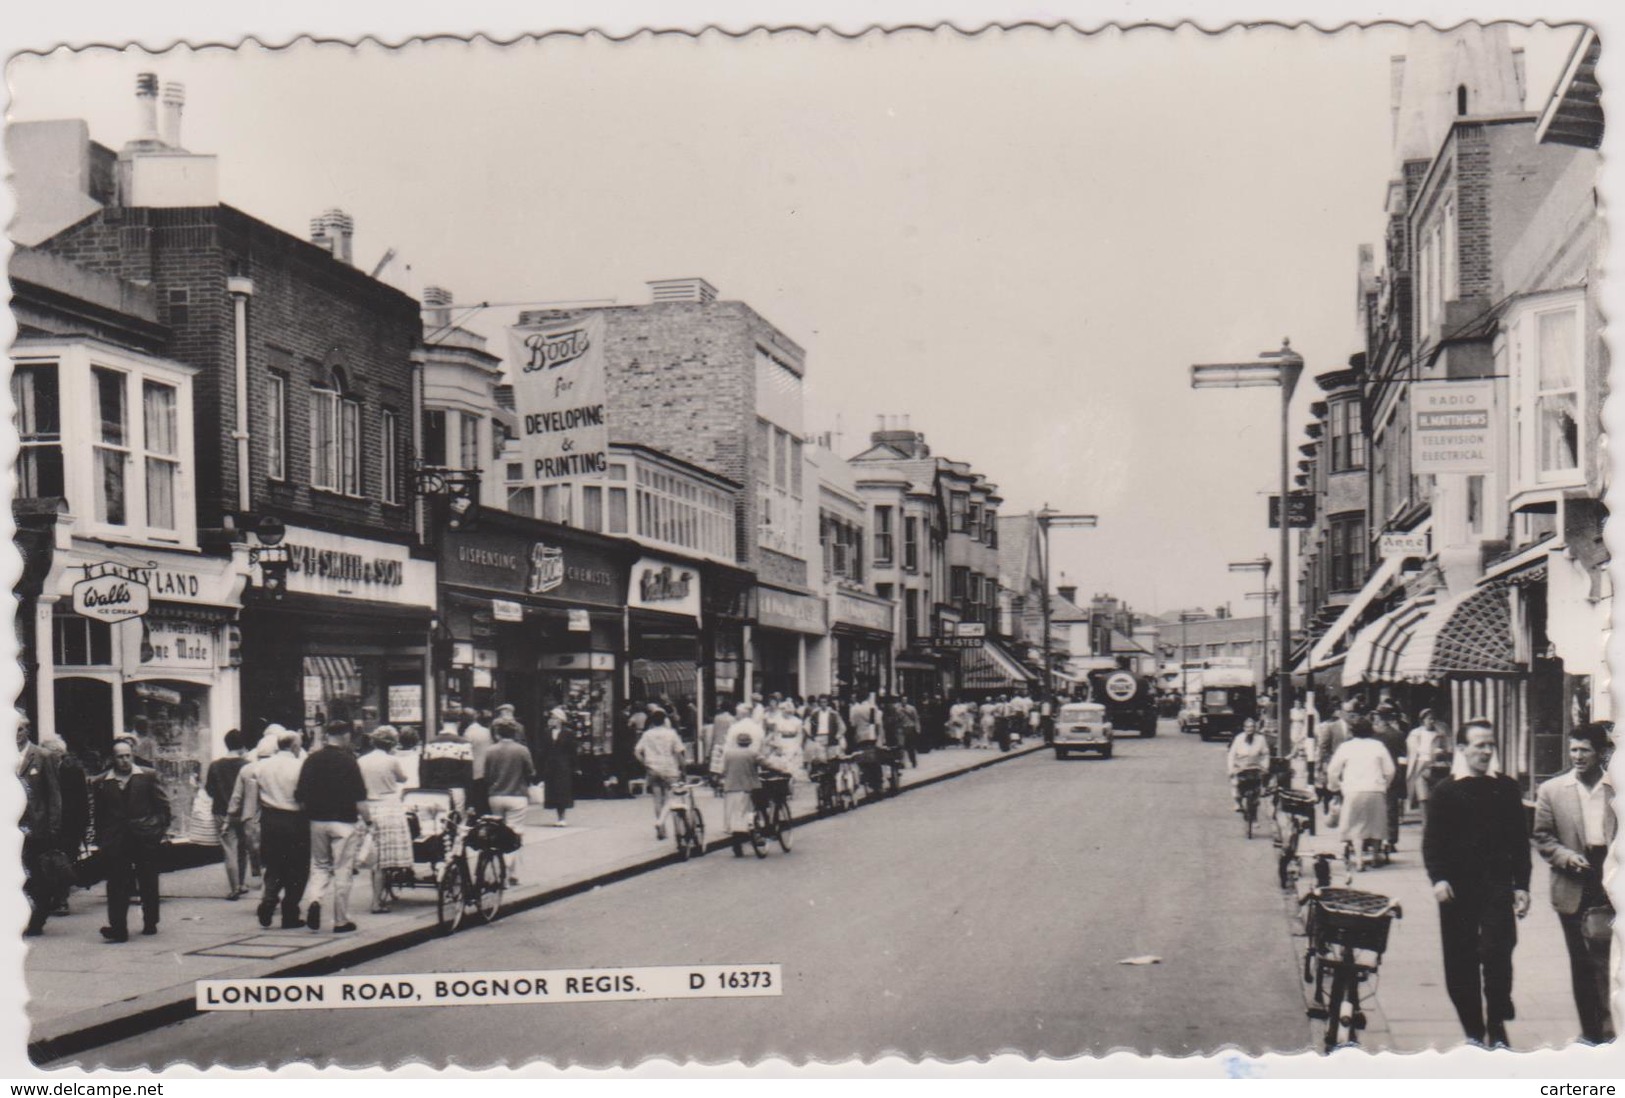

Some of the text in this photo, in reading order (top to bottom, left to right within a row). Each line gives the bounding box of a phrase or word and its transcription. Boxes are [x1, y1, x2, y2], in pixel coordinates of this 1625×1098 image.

[523, 329, 590, 373] Boots
[554, 377, 573, 398] for
[1429, 394, 1476, 405] RADIO
[525, 404, 604, 435] DEVELOPING
[561, 437, 574, 451] &
[1421, 434, 1484, 446] TELEVISION
[534, 452, 606, 479] PRINTING
[1421, 449, 1484, 461] ELECTRICAL
[319, 548, 363, 581] SMITH
[374, 557, 402, 587] SON
[459, 546, 516, 570] DISPENSING
[568, 566, 611, 585] CHEMISTS
[83, 582, 131, 608] Wall's
[175, 637, 207, 660] Made
